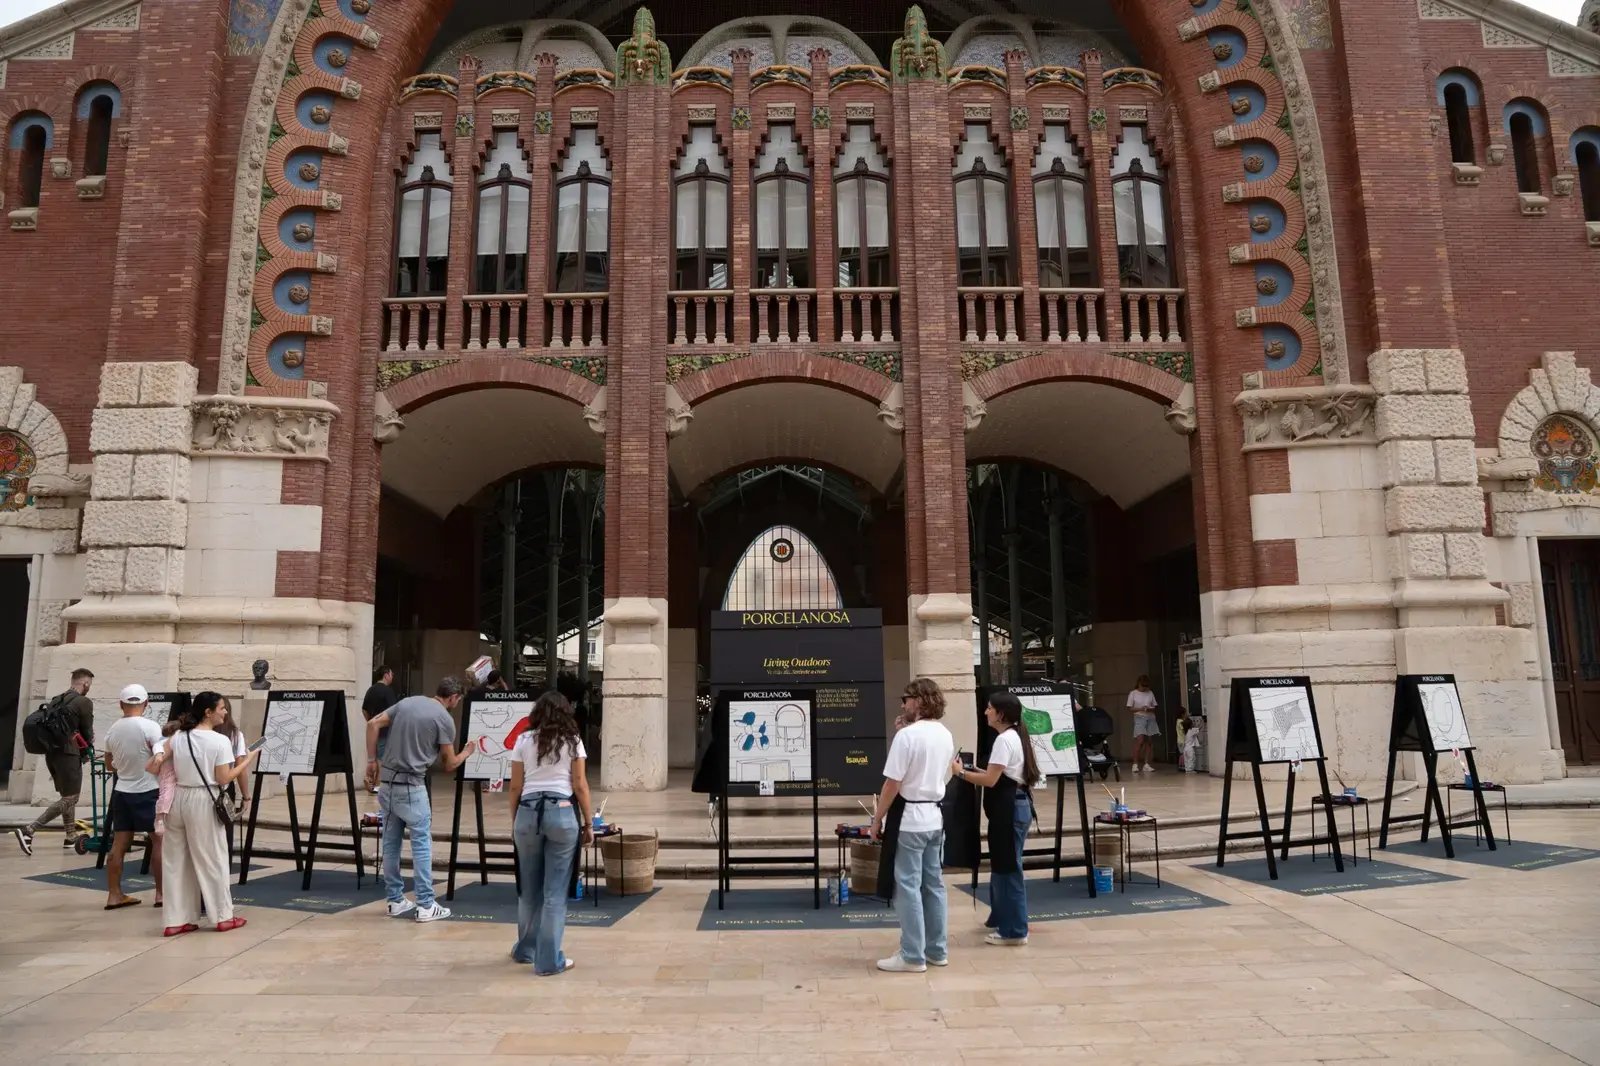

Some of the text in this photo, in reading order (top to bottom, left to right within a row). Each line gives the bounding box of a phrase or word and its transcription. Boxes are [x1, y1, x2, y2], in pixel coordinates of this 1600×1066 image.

[742, 611, 850, 625] PORCELANOSA
[763, 657, 831, 668] Living Outdoors
[743, 691, 792, 699] PORCELANOSA
